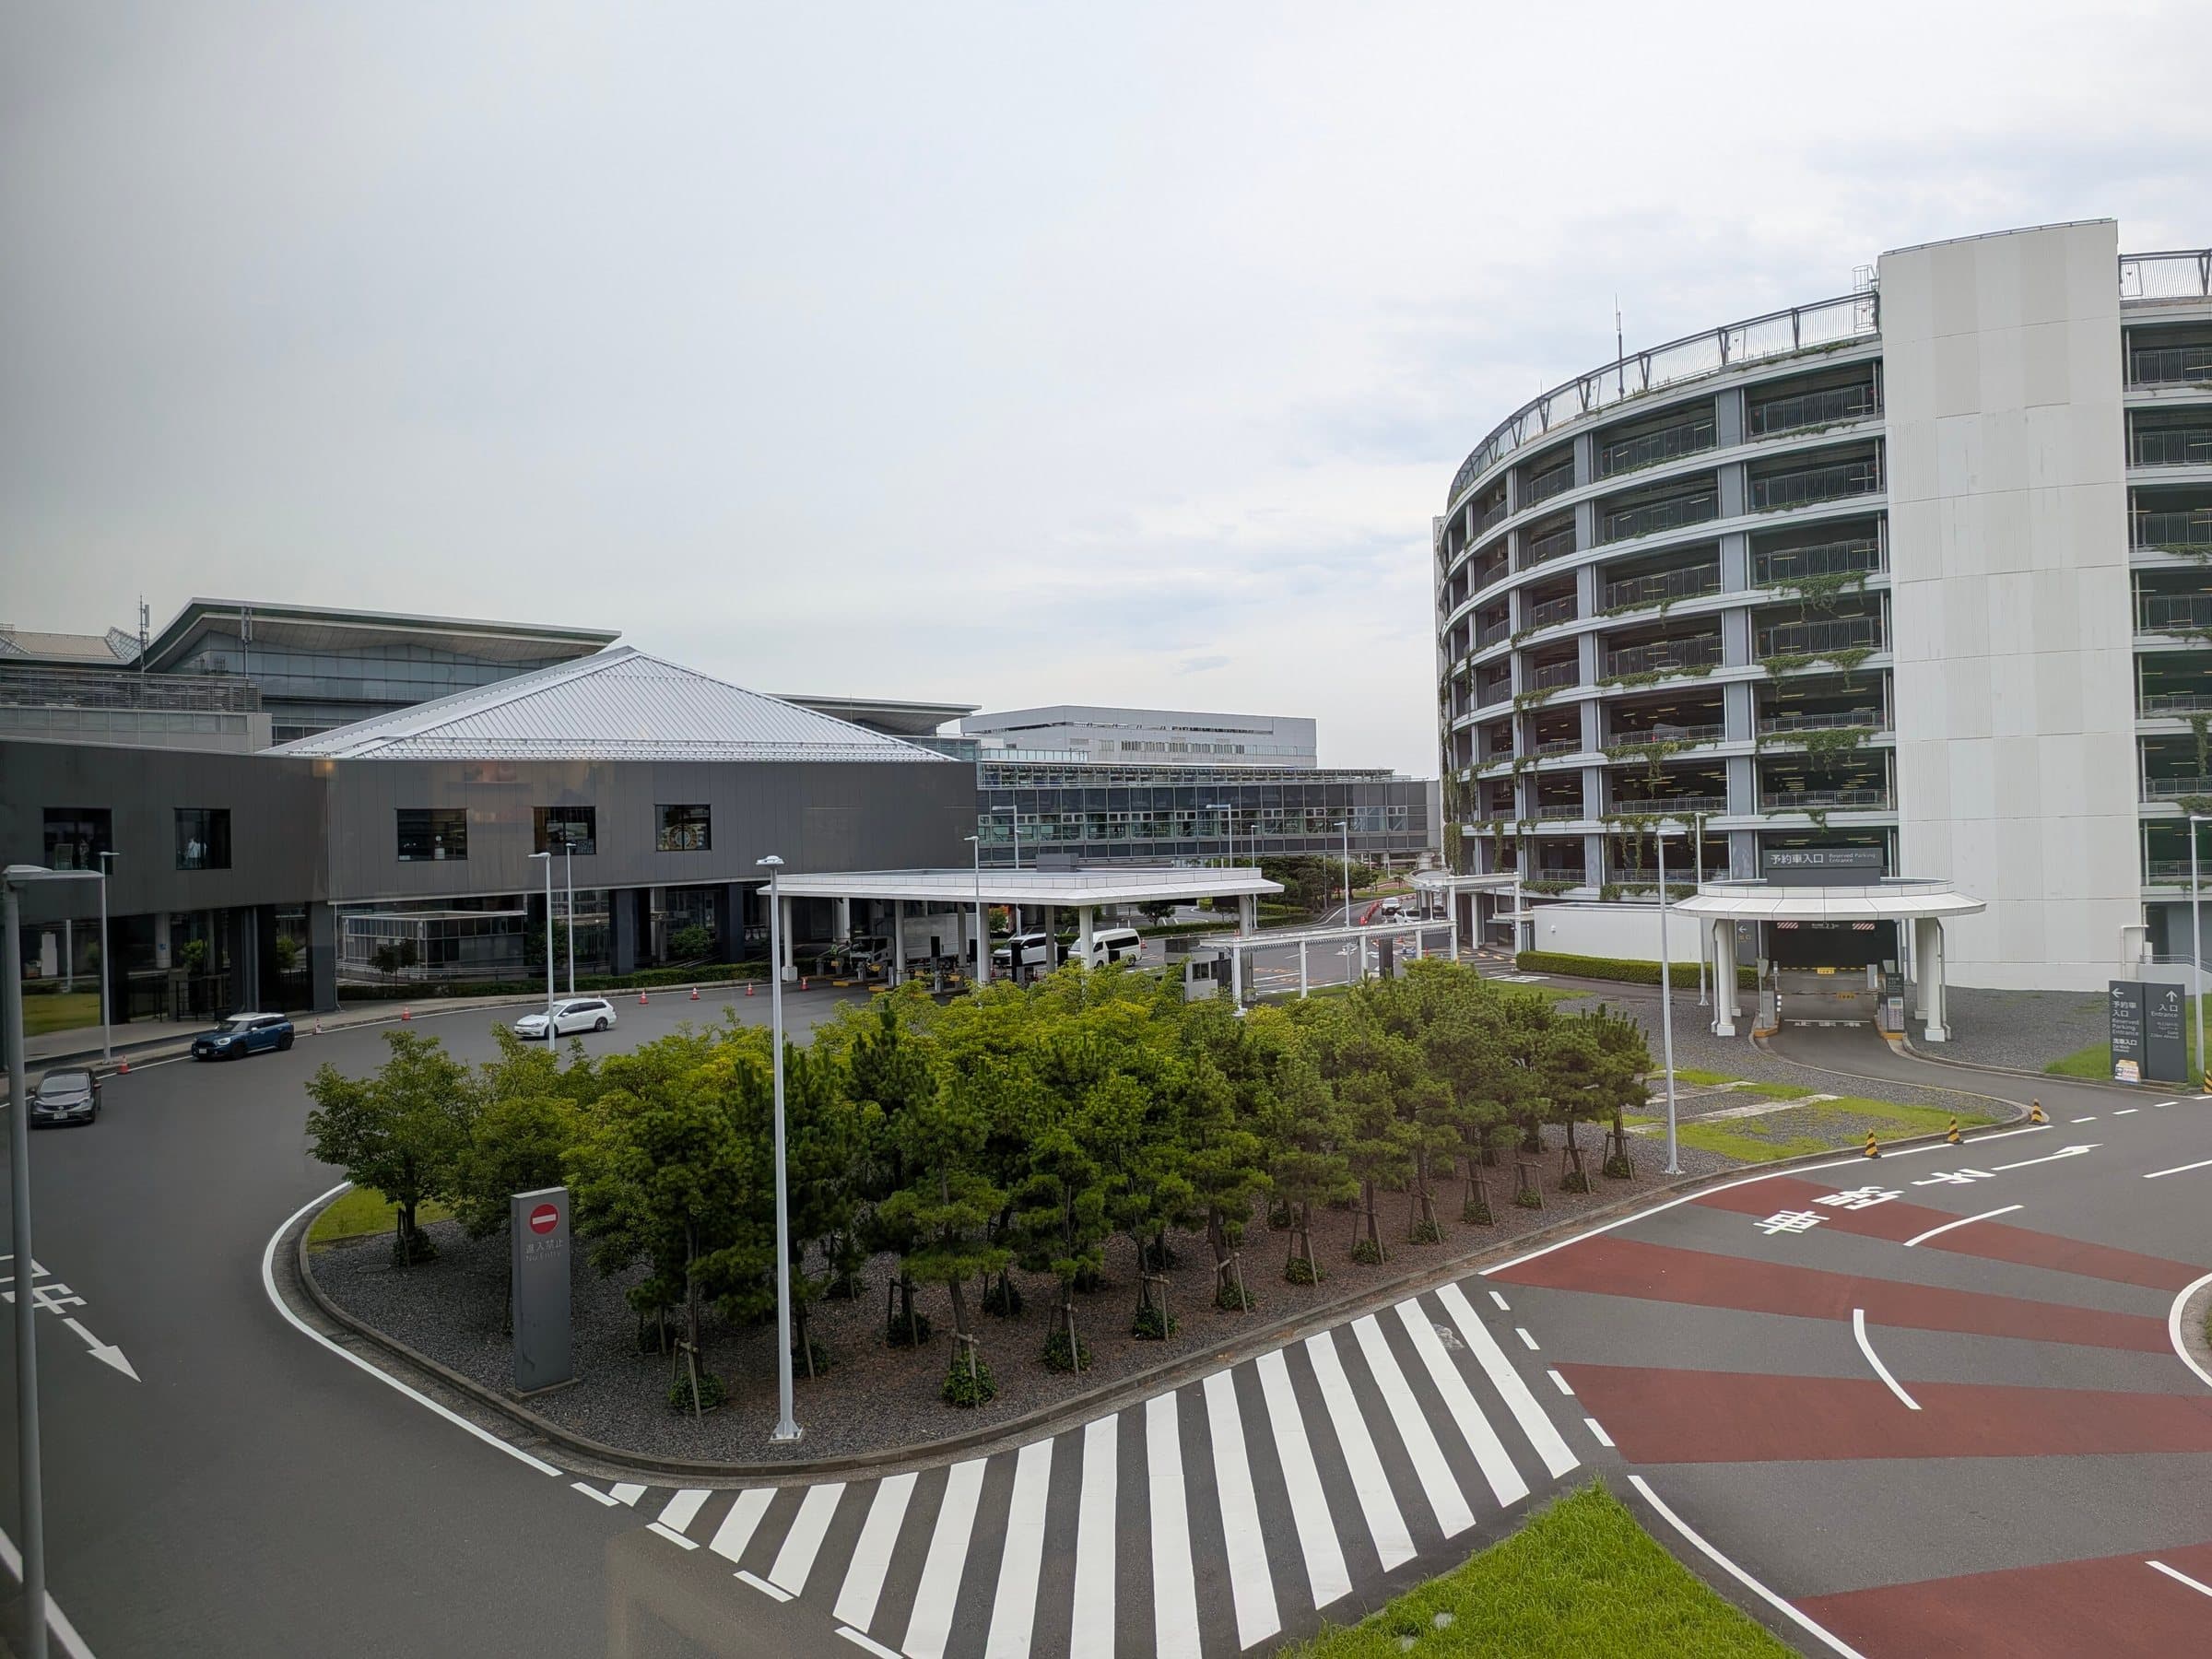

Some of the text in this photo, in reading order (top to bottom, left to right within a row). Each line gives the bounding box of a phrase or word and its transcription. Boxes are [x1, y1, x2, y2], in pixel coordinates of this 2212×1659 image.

[1770, 853, 1823, 865] 予約車入口
[2158, 1004, 2179, 1012] 入口
